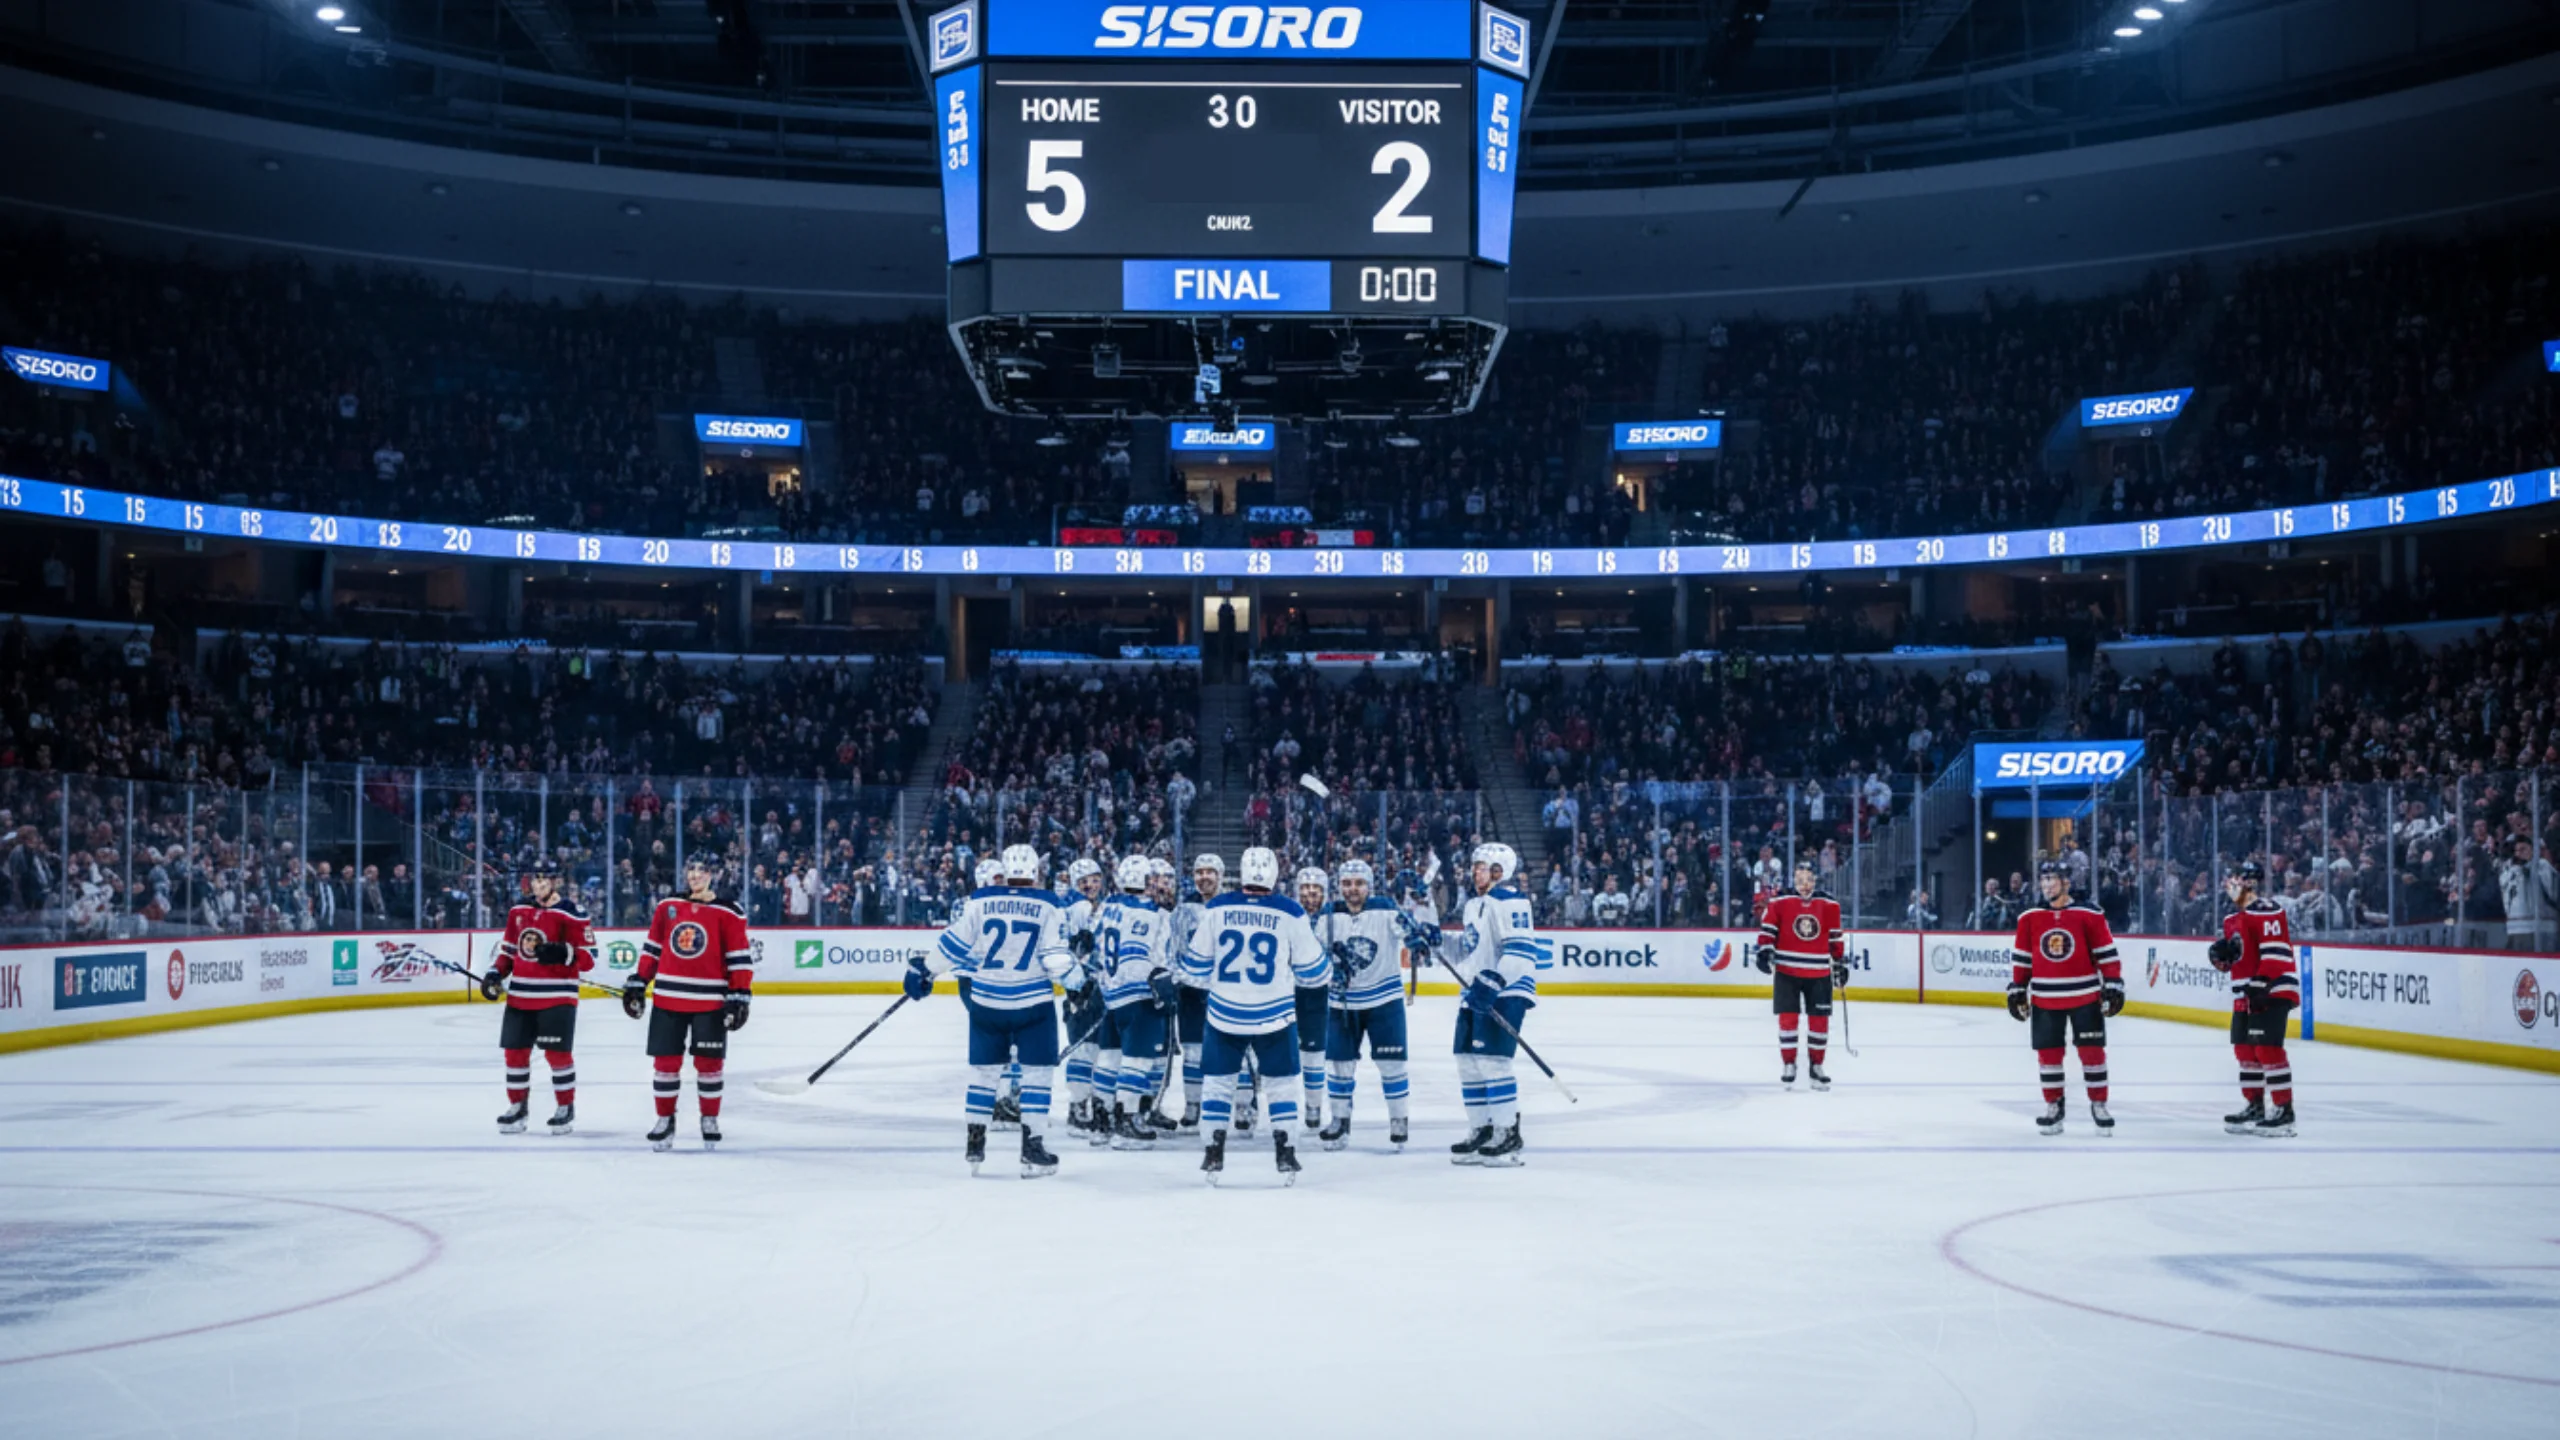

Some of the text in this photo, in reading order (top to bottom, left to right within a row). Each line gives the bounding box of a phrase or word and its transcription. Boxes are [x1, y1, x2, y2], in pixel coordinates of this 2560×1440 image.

[1094, 6, 1363, 49] SISORO
[1021, 98, 1100, 123] HOME
[1338, 99, 1441, 124] VISITOR
[1025, 139, 1433, 233] 5 2
[1174, 266, 1437, 302] FINAL 0:00
[61, 488, 84, 515] 15
[310, 517, 338, 542] 20
[443, 527, 472, 552] 20
[642, 540, 669, 564] 20
[1995, 750, 2126, 778] SISORO
[983, 918, 1041, 971] 27
[1562, 943, 1659, 968] Ronck
